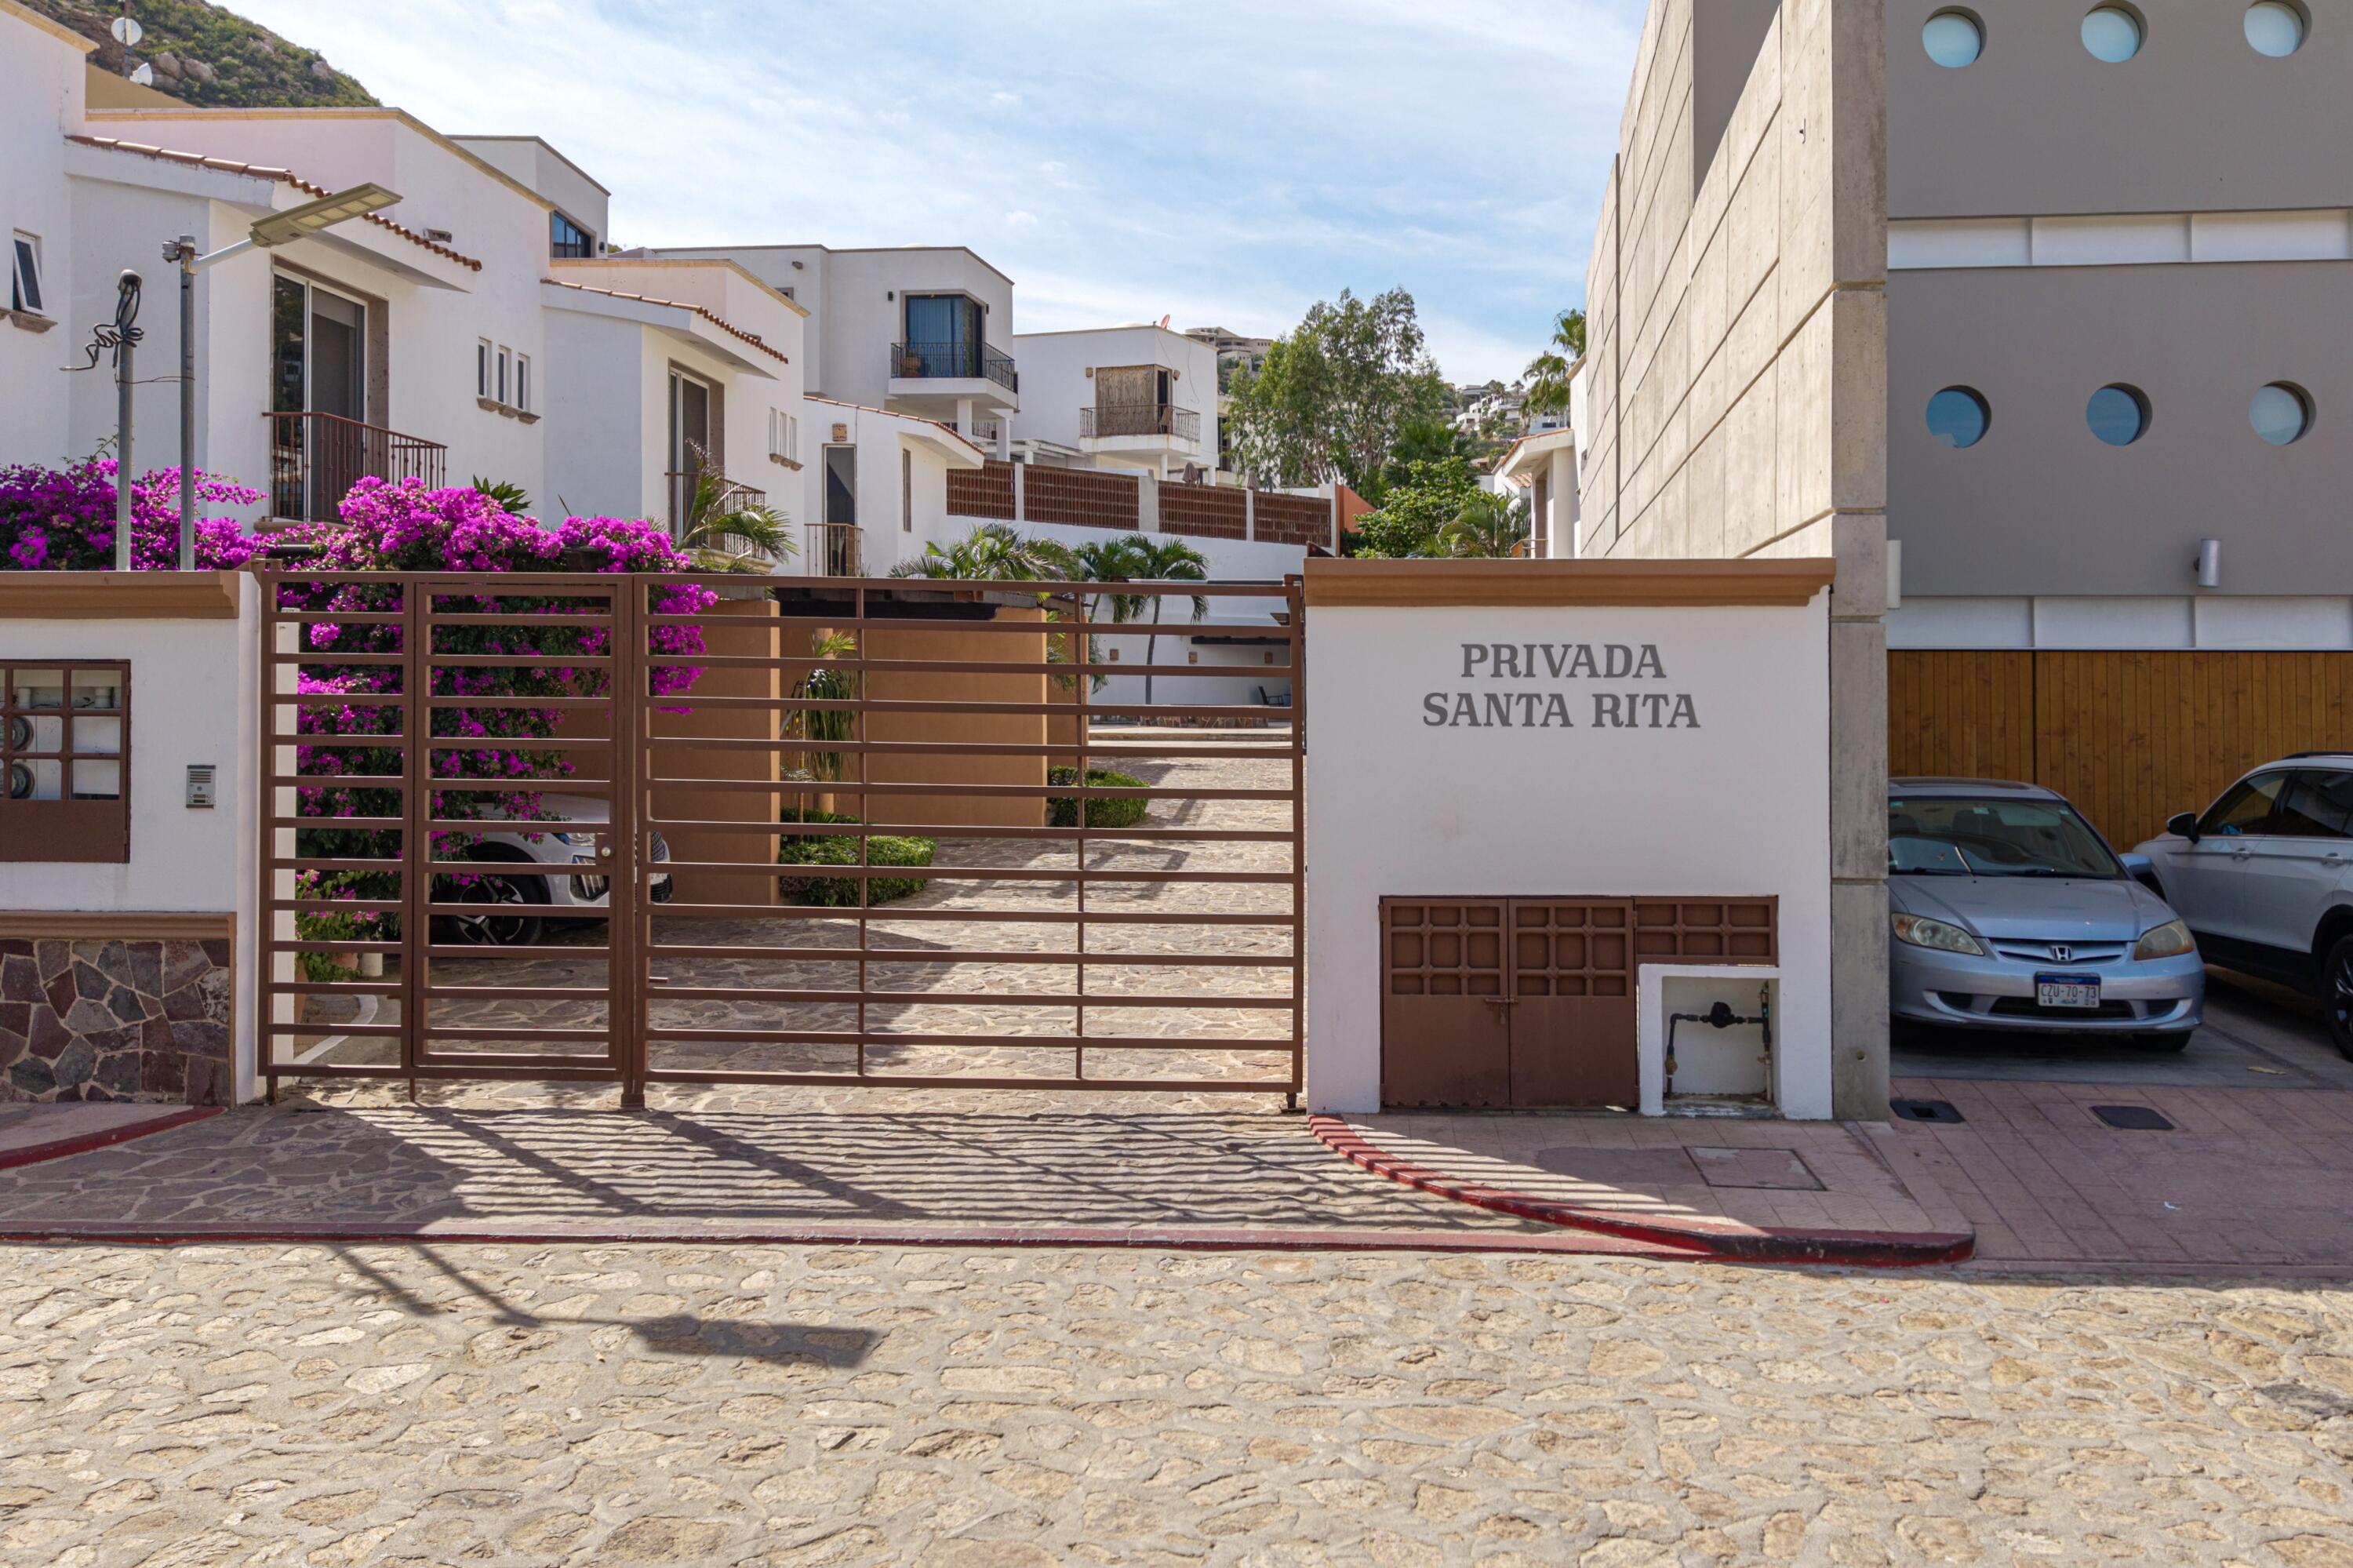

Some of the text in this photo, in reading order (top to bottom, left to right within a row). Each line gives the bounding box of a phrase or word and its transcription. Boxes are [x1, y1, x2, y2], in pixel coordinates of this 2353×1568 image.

[1460, 643, 1667, 678] PRIVADA
[1423, 692, 1701, 728] SANTA RITA
[2041, 984, 2097, 999] CZU-70-73
